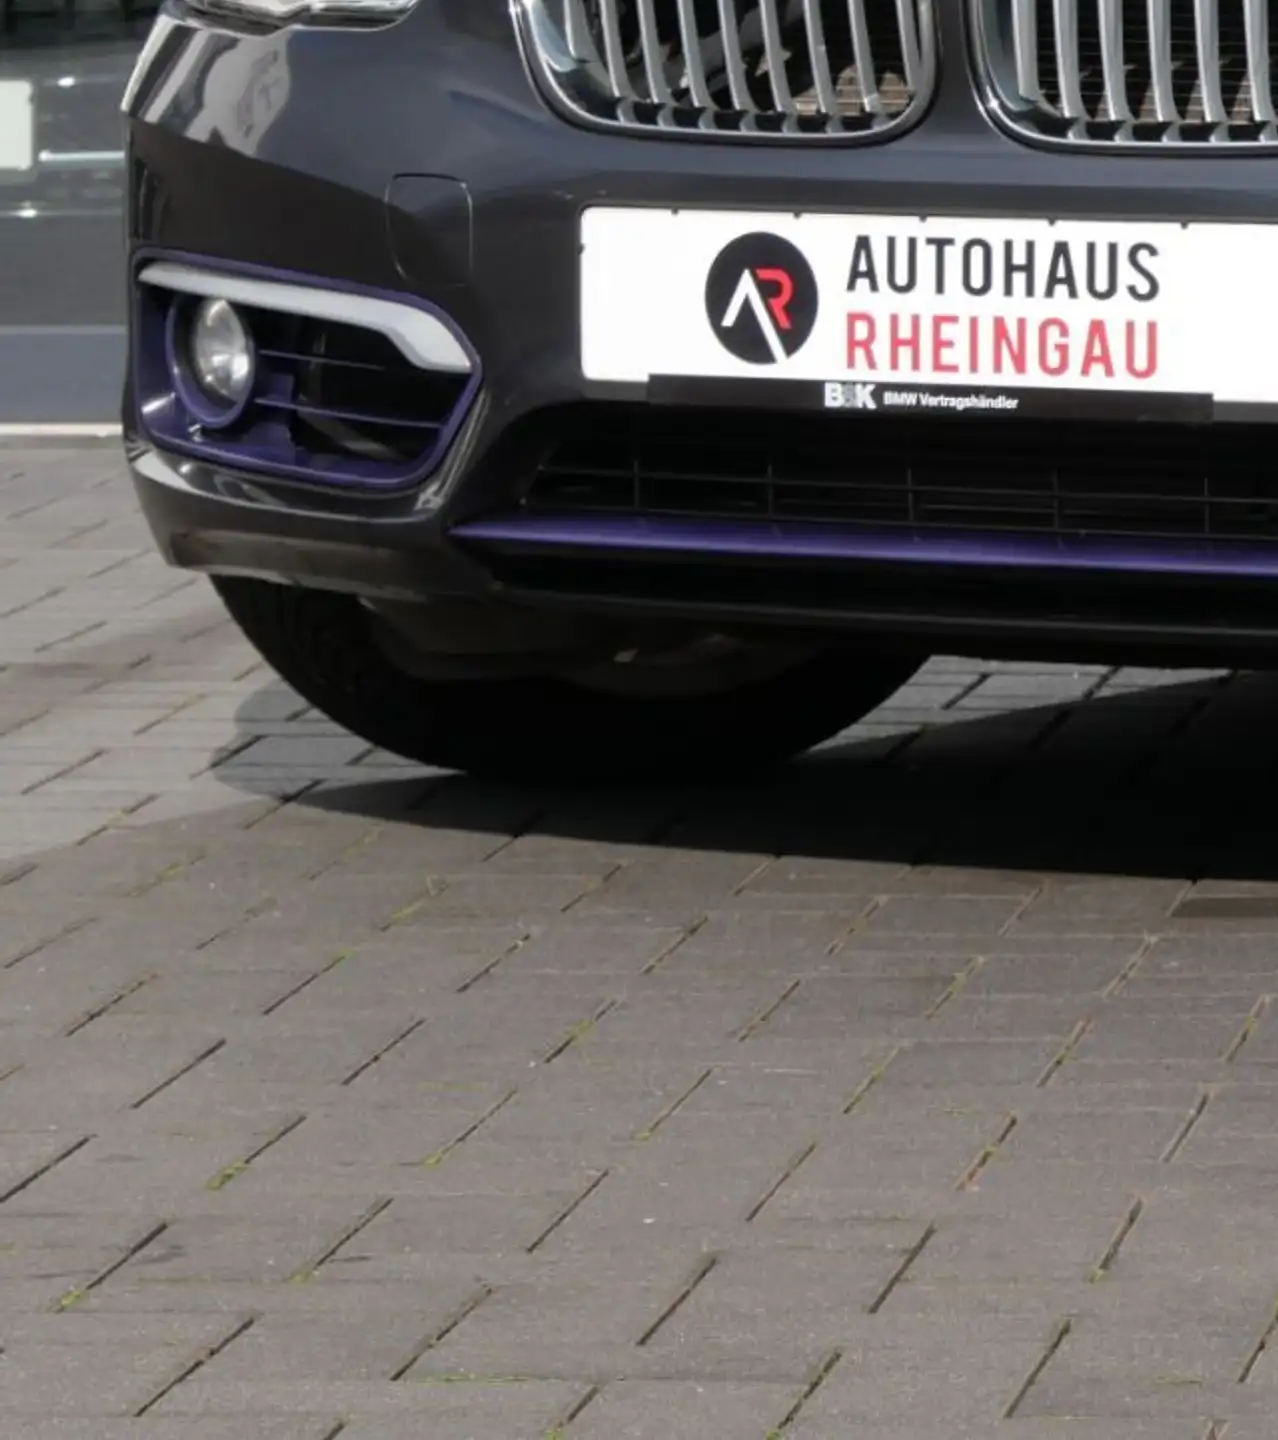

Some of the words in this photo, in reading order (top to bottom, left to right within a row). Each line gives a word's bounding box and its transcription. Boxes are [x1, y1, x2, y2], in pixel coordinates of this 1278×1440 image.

[847, 235, 1159, 301] AUTOHAUS
[847, 313, 1157, 379] RHEINGAU
[883, 391, 917, 406] BMW
[919, 392, 1018, 411] Vertragshändler
